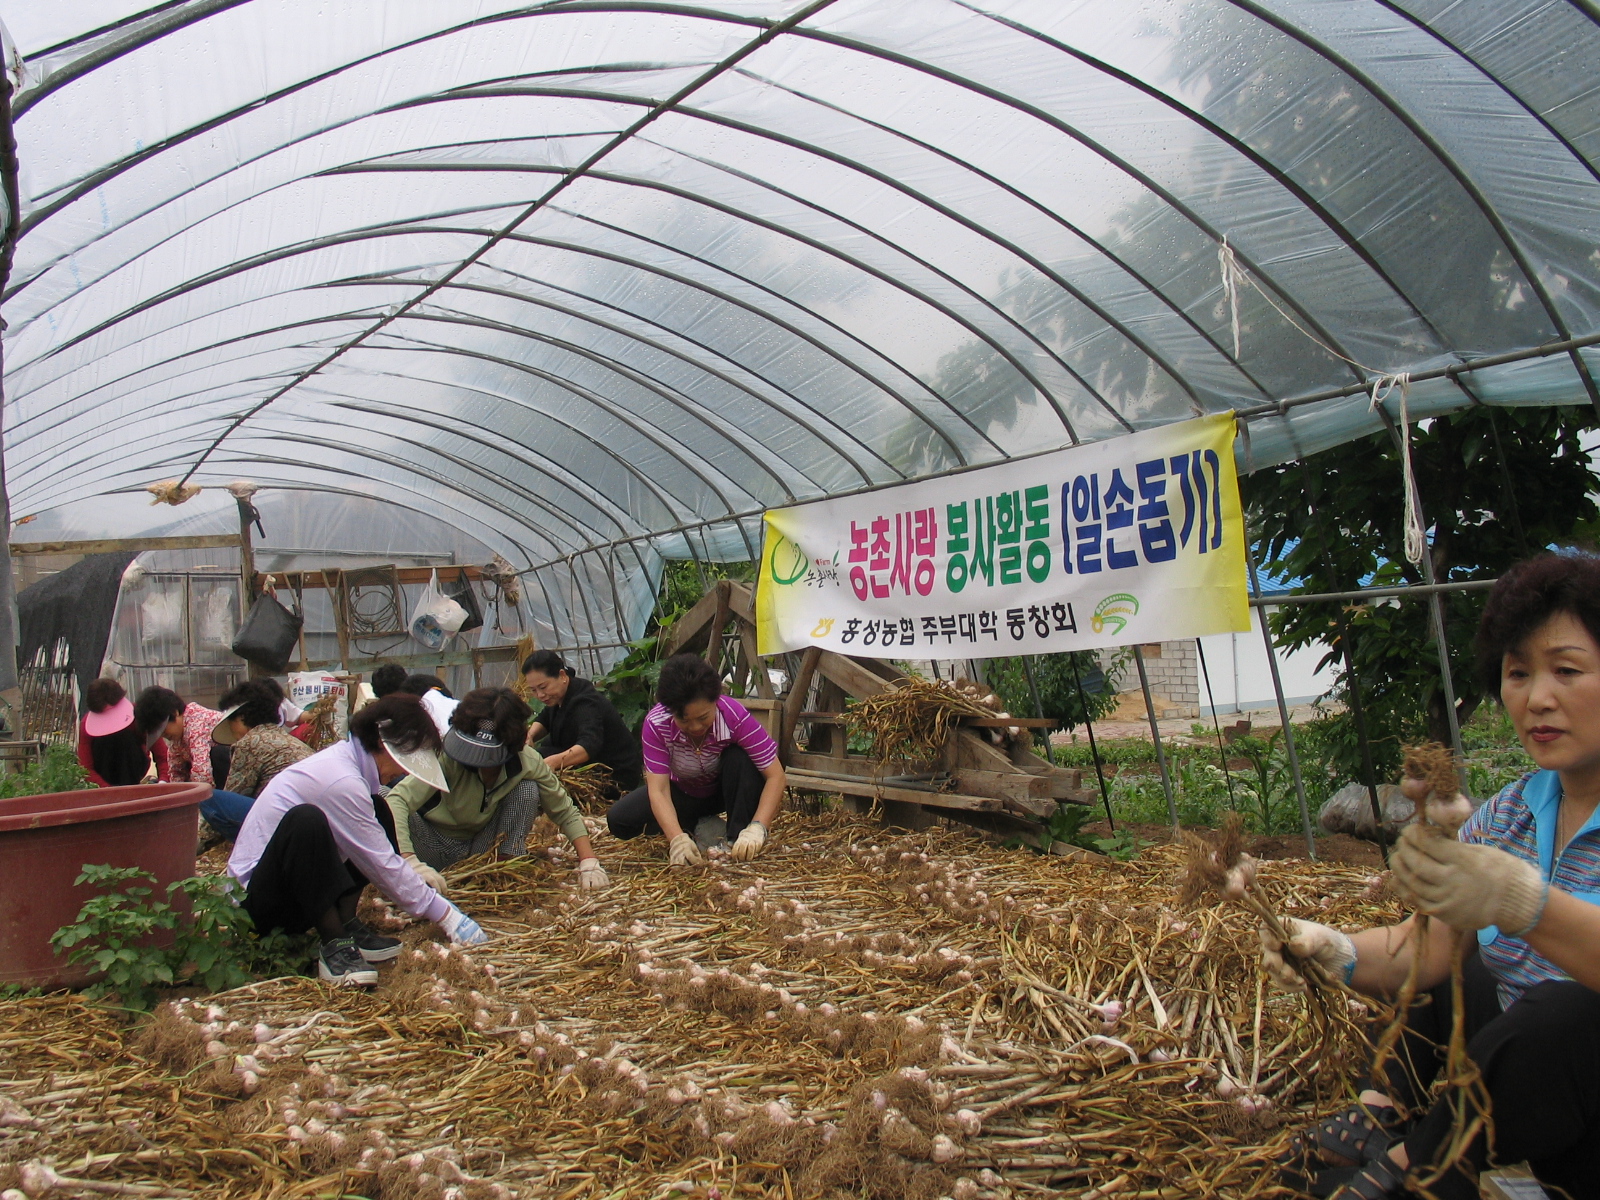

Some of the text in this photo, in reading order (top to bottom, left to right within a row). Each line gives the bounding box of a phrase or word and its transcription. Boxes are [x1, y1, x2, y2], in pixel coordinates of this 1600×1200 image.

[848, 507, 938, 601] 농촌사랑
[946, 484, 1051, 593] 봉사활동
[841, 602, 1078, 646] 홍성농협 주부대학 동창회
